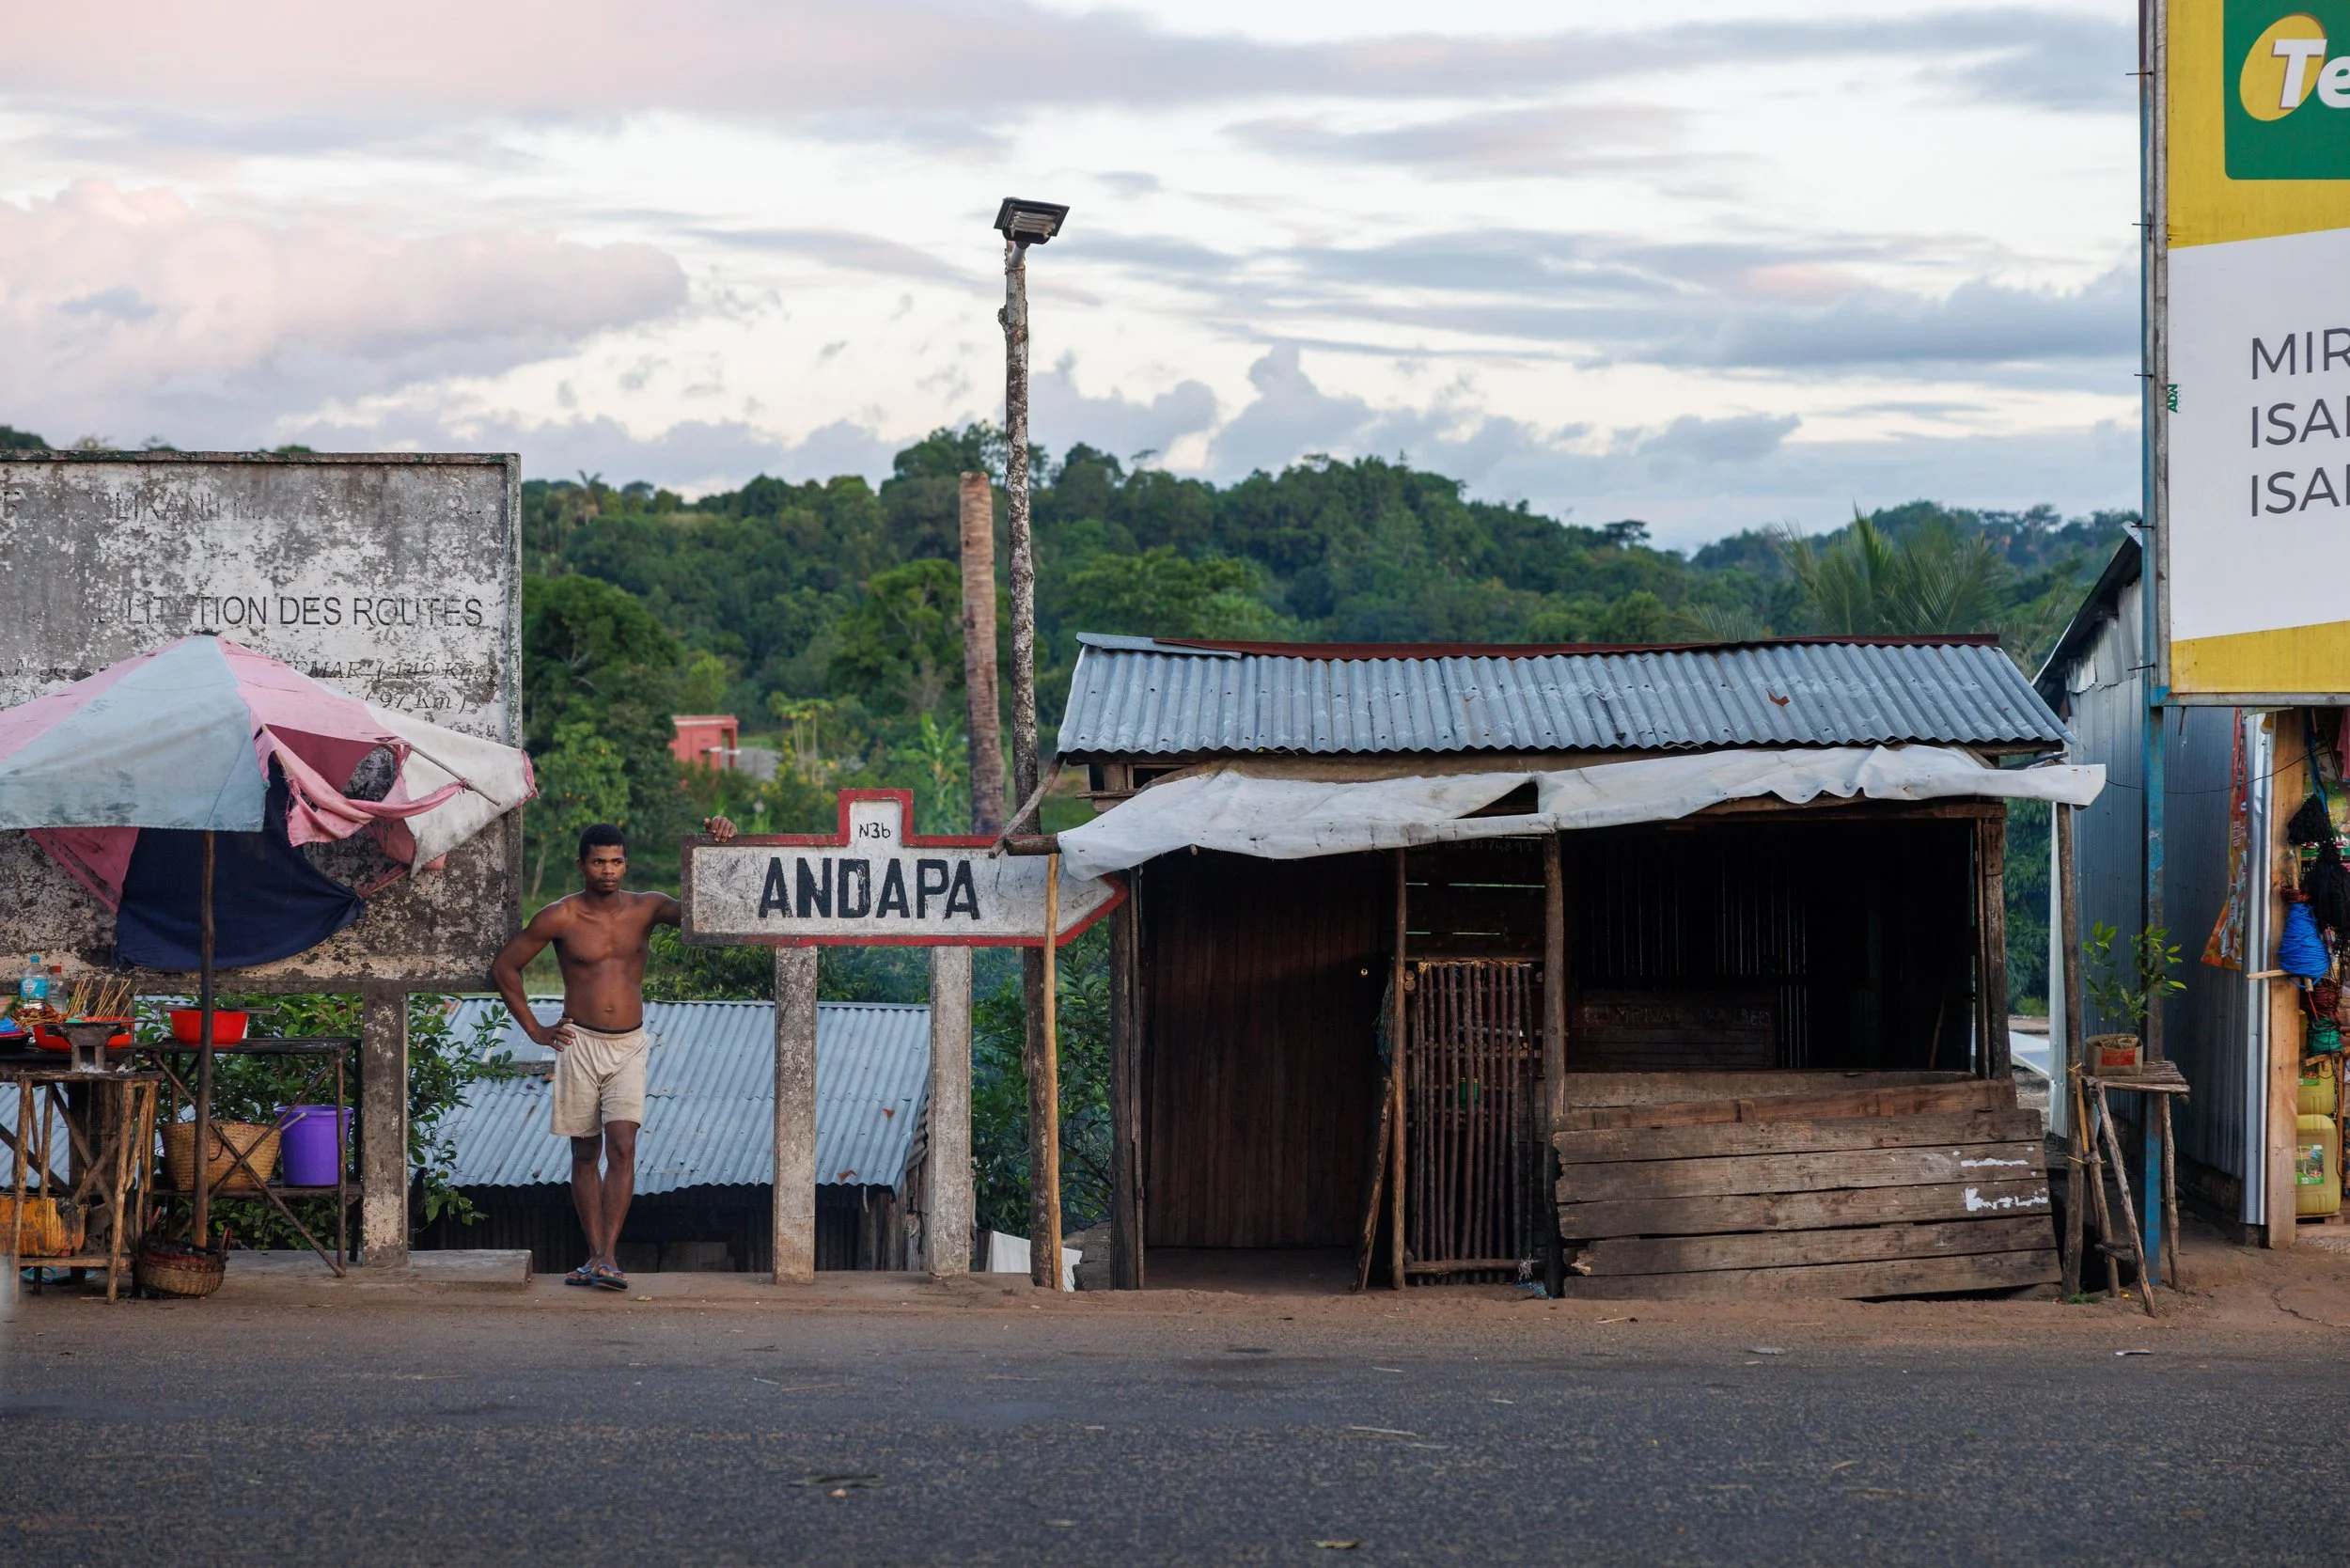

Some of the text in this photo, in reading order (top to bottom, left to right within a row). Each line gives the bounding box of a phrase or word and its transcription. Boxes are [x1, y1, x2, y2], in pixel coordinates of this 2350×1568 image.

[2273, 39, 2350, 109] Te
[2252, 395, 2350, 447] ISA
[2251, 463, 2350, 516] ISA
[279, 596, 341, 625] DES
[353, 597, 482, 626] ROUTES
[758, 856, 980, 920] ANDAPA
